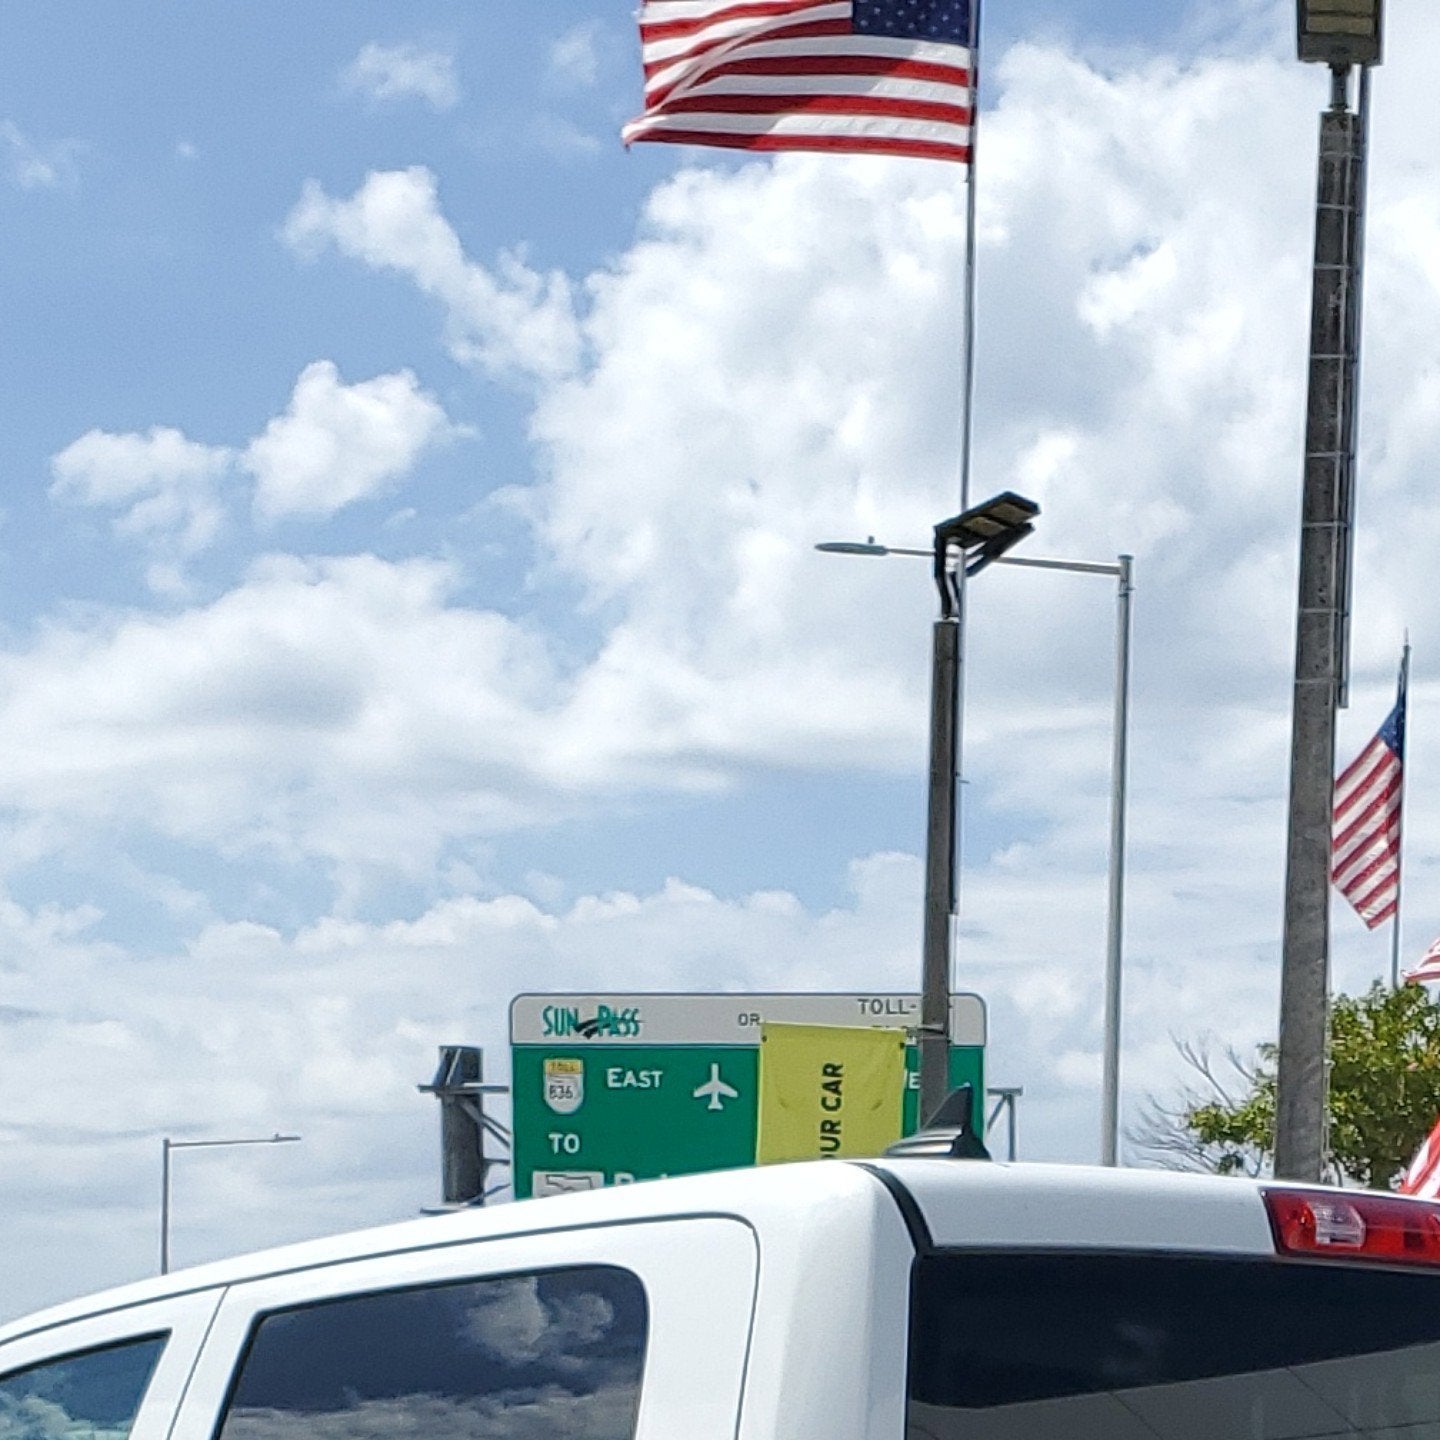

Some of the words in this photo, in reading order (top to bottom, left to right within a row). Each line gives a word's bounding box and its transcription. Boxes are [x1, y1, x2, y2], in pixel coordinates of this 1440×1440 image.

[738, 1013, 760, 1027] OR
[606, 1067, 662, 1088] EAST
[821, 1062, 844, 1112] CAR
[548, 1133, 580, 1154] TO
